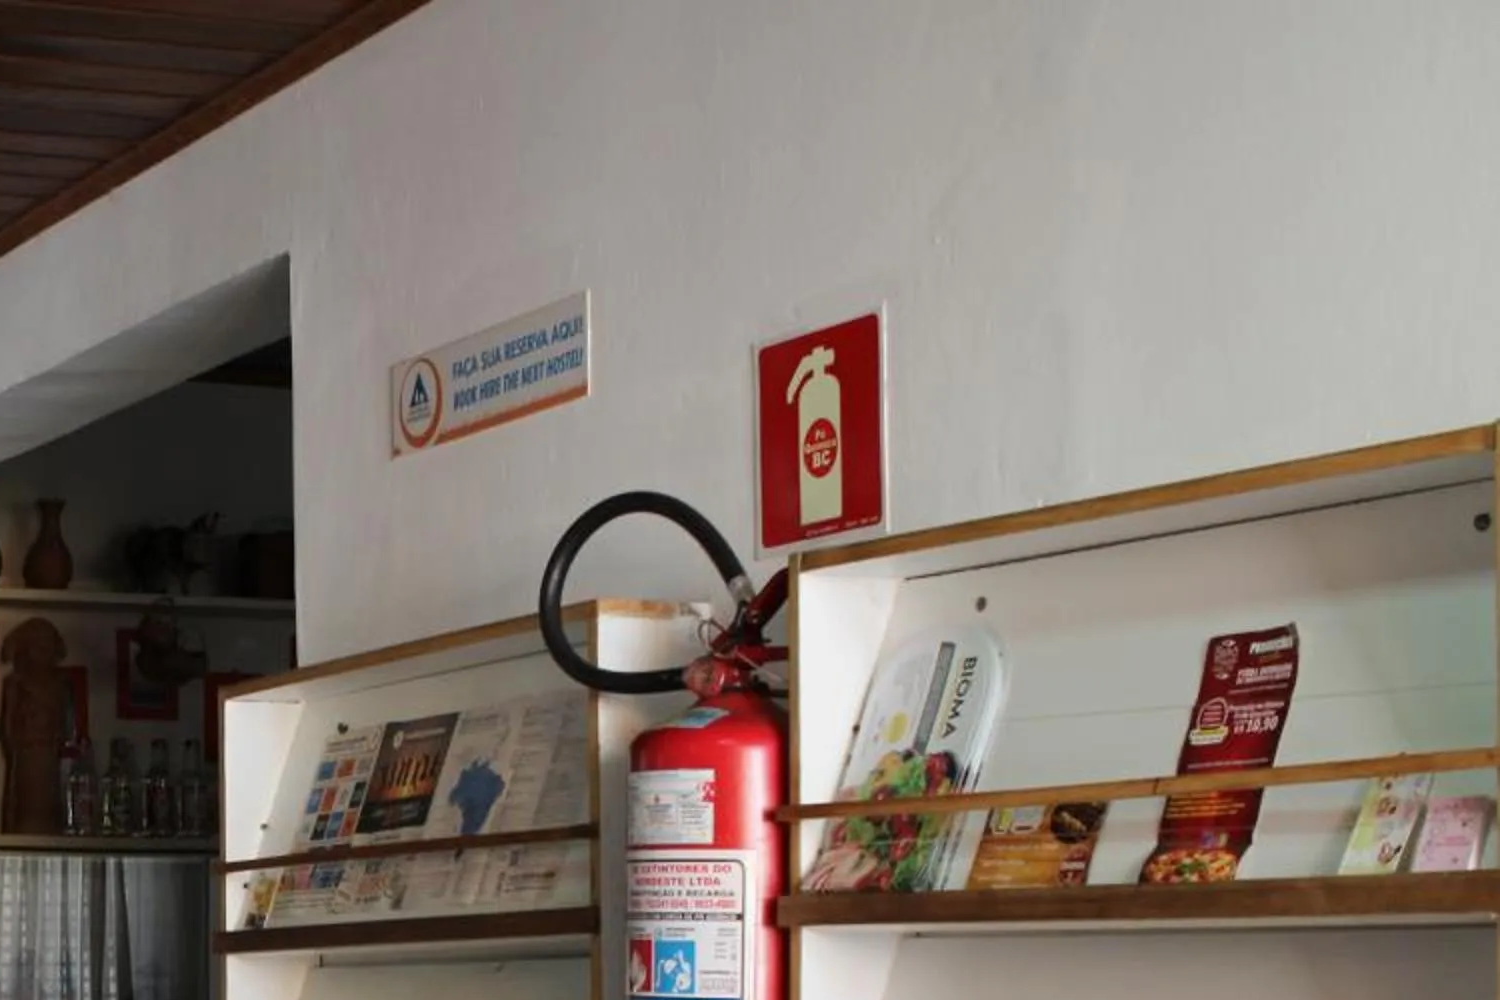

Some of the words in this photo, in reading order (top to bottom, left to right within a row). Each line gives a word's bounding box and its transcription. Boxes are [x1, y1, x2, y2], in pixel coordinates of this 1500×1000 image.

[481, 346, 502, 371] SUA
[504, 328, 549, 360] RESERVA
[812, 449, 831, 468] BC
[941, 655, 978, 739] BIOMA
